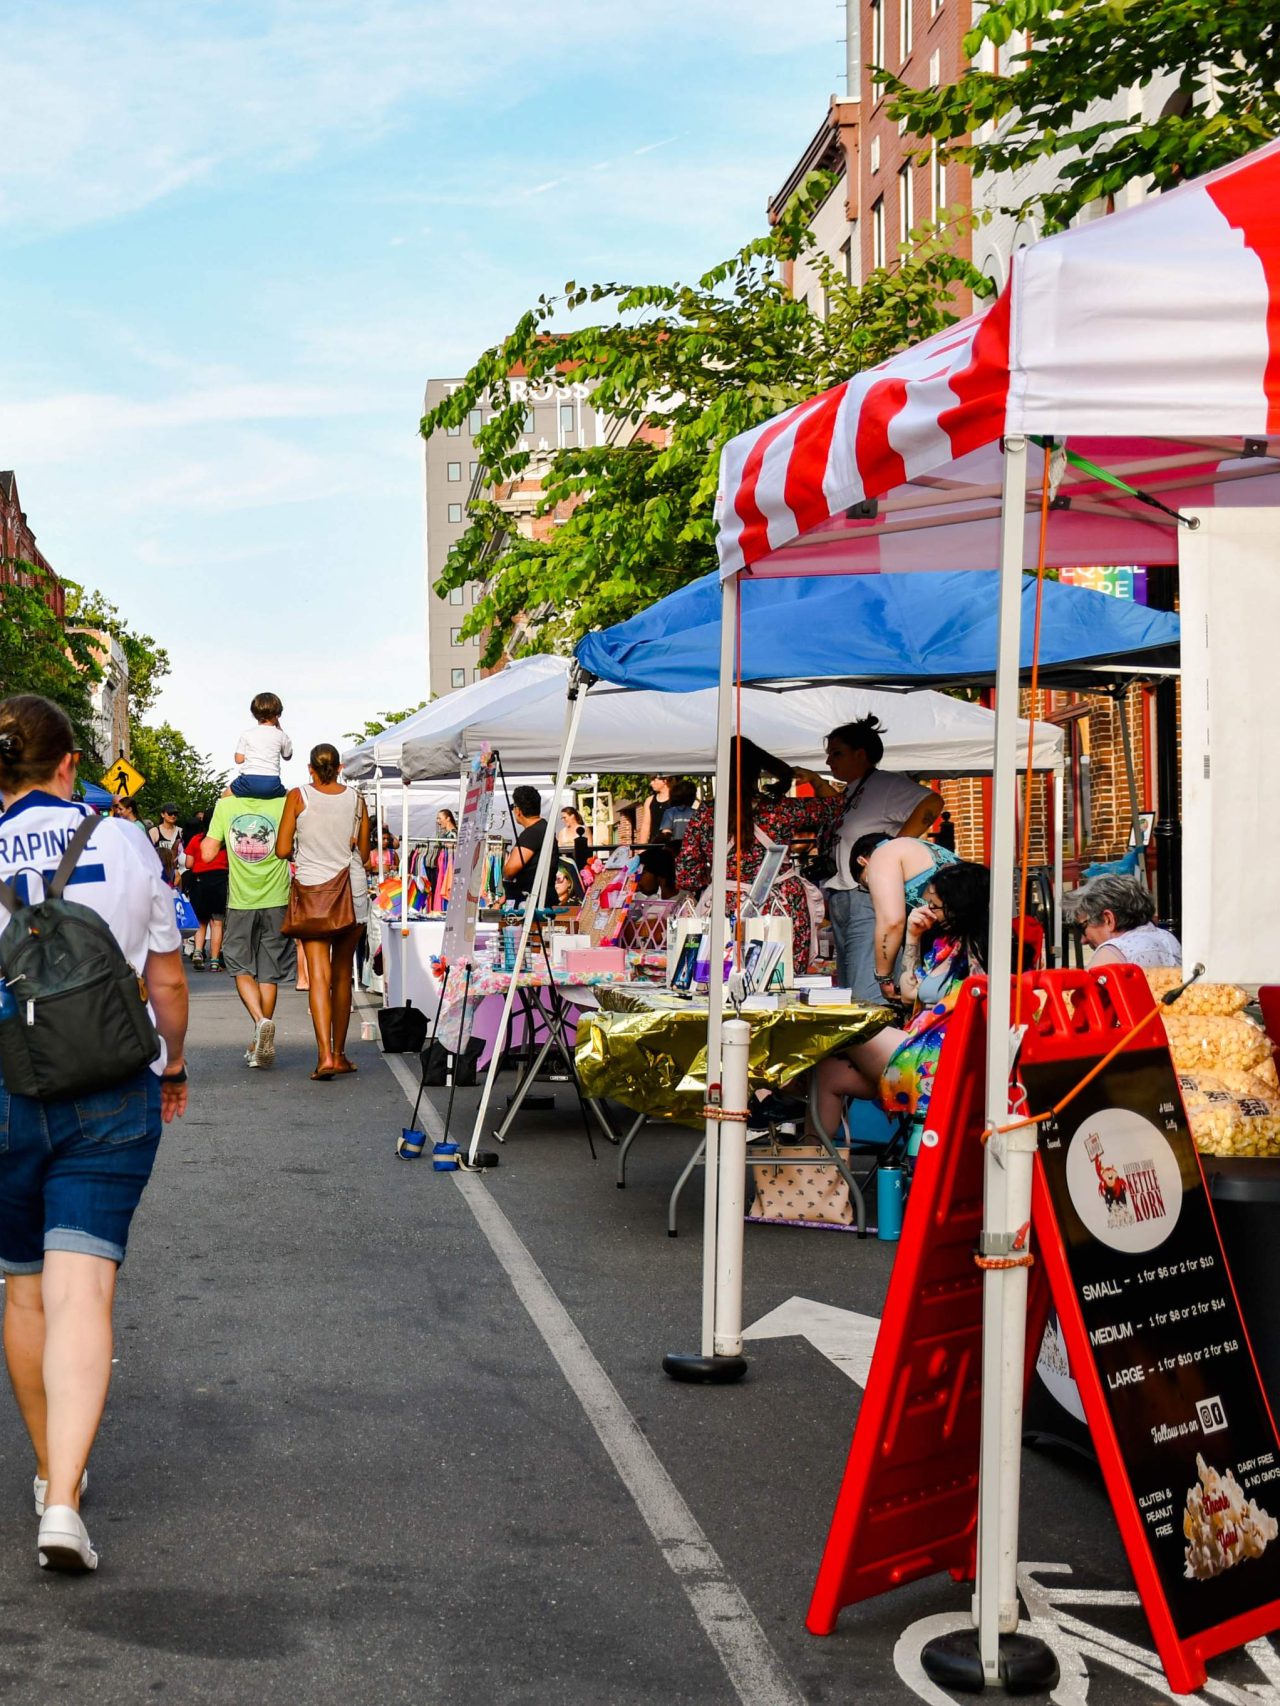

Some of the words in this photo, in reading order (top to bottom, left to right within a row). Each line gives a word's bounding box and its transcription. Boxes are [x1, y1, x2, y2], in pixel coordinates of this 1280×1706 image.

[1125, 1169, 1160, 1195] KETTLE
[1131, 1190, 1167, 1223] KORN
[1082, 1278, 1123, 1301] SMALL
[1137, 1272, 1144, 1284] 1
[1144, 1269, 1156, 1282] for
[1157, 1266, 1169, 1280] $6
[1169, 1265, 1178, 1276] or
[1179, 1262, 1186, 1273] 2
[1186, 1259, 1198, 1271] for
[1199, 1255, 1214, 1269] $10
[1089, 1321, 1134, 1347] MEDIUM
[1149, 1316, 1155, 1327] 1
[1155, 1313, 1167, 1325] for
[1169, 1309, 1181, 1322] $8
[1181, 1307, 1190, 1318] or
[1191, 1305, 1198, 1316] 2
[1198, 1302, 1209, 1314] for
[1211, 1297, 1226, 1311] $14
[1106, 1364, 1145, 1389] LARGE
[1157, 1360, 1164, 1372] 1
[1163, 1357, 1176, 1370] for
[1177, 1352, 1193, 1366] $10
[1193, 1350, 1202, 1361] or
[1203, 1347, 1210, 1358] 2
[1210, 1344, 1222, 1356] for
[1223, 1339, 1239, 1353] $18
[1151, 1422, 1179, 1444] Follow
[1178, 1425, 1188, 1436] us
[1188, 1419, 1199, 1432] on
[1237, 1458, 1256, 1473] DAIRY
[1257, 1452, 1275, 1465] FREE
[1244, 1478, 1250, 1489] &
[1250, 1474, 1261, 1486] NO
[1138, 1491, 1165, 1508] GLUTEN
[1166, 1488, 1173, 1499] &
[1146, 1505, 1174, 1523] PEANUT
[1155, 1524, 1174, 1539] FREE
